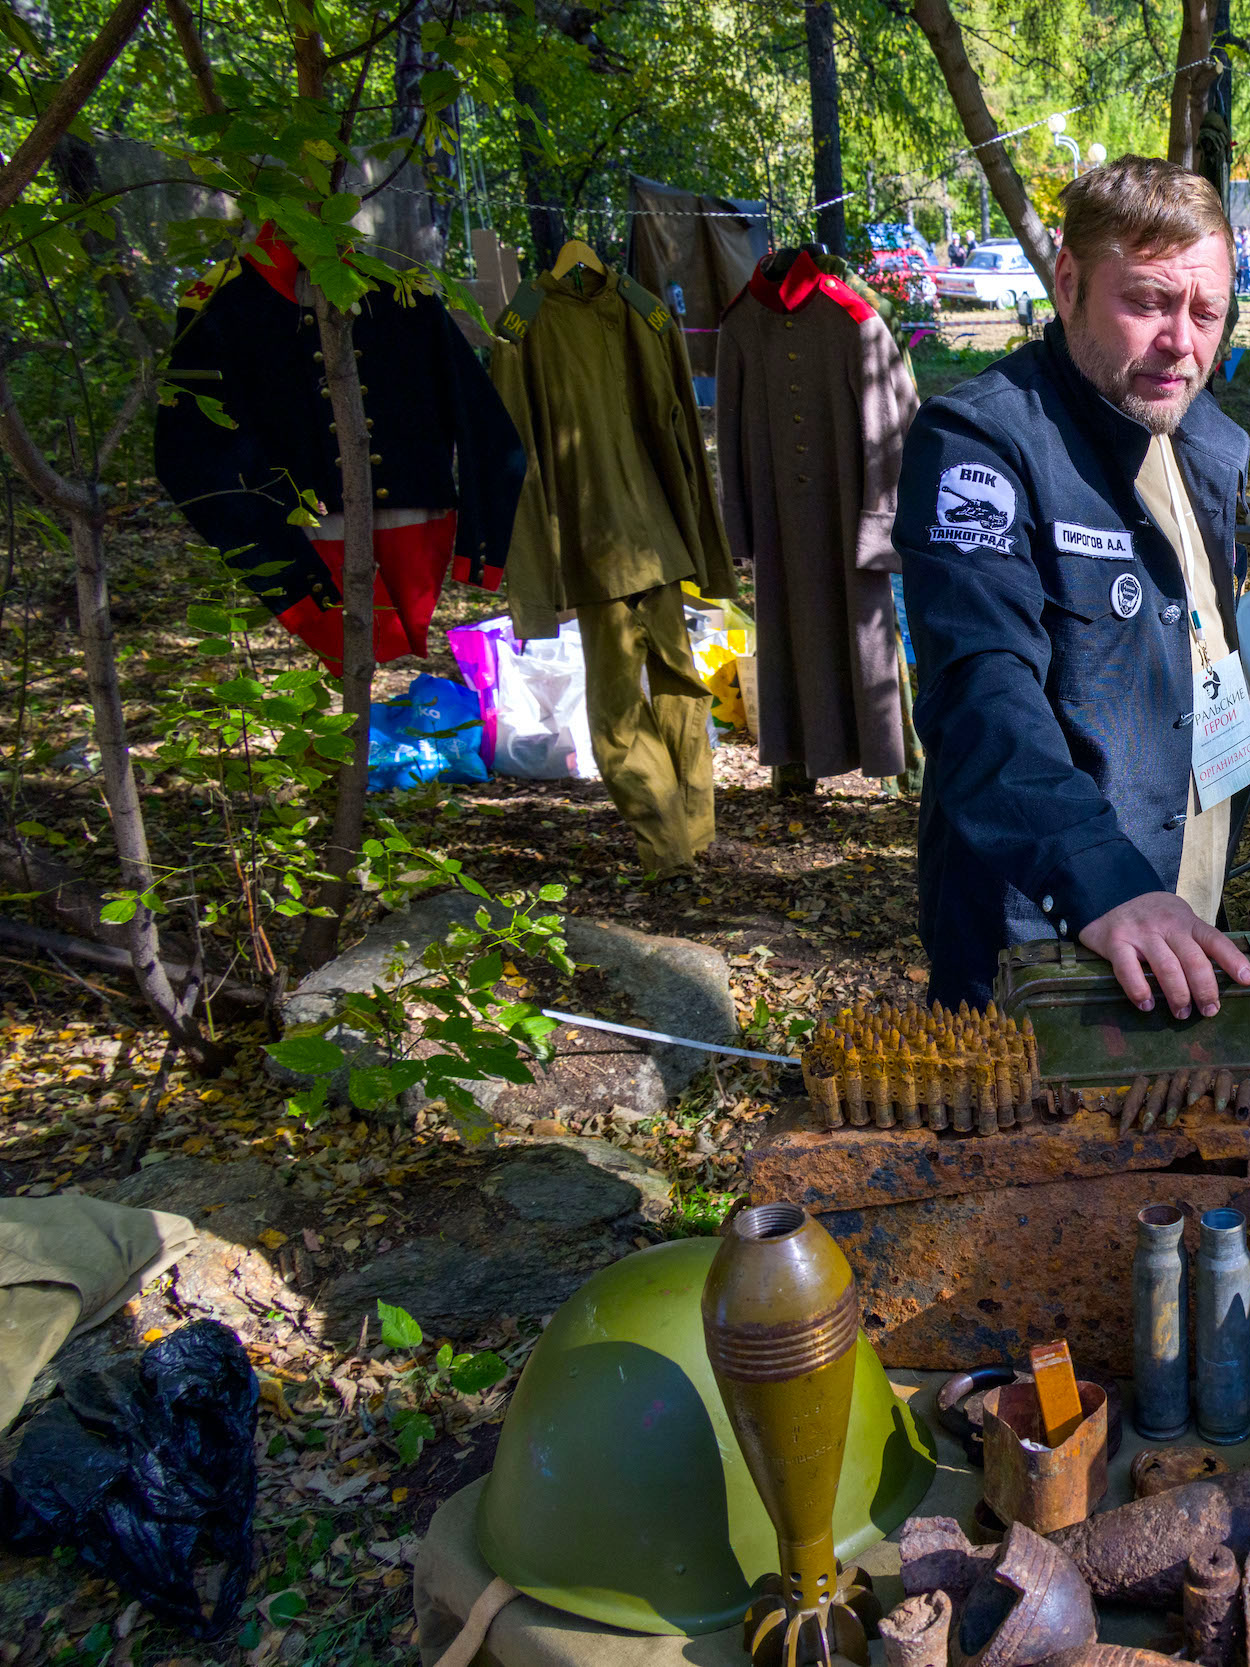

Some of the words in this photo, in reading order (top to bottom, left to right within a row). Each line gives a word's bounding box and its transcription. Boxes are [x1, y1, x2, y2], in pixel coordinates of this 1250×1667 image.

[960, 468, 997, 487] ВПК
[931, 528, 1007, 549] ТАНКОГРАД
[1063, 530, 1103, 549] ПИРОГОВ
[1107, 538, 1127, 551] А.А.
[1195, 688, 1246, 726] РАЛЬСКИЕ
[1204, 709, 1237, 736] ГЕРОИ
